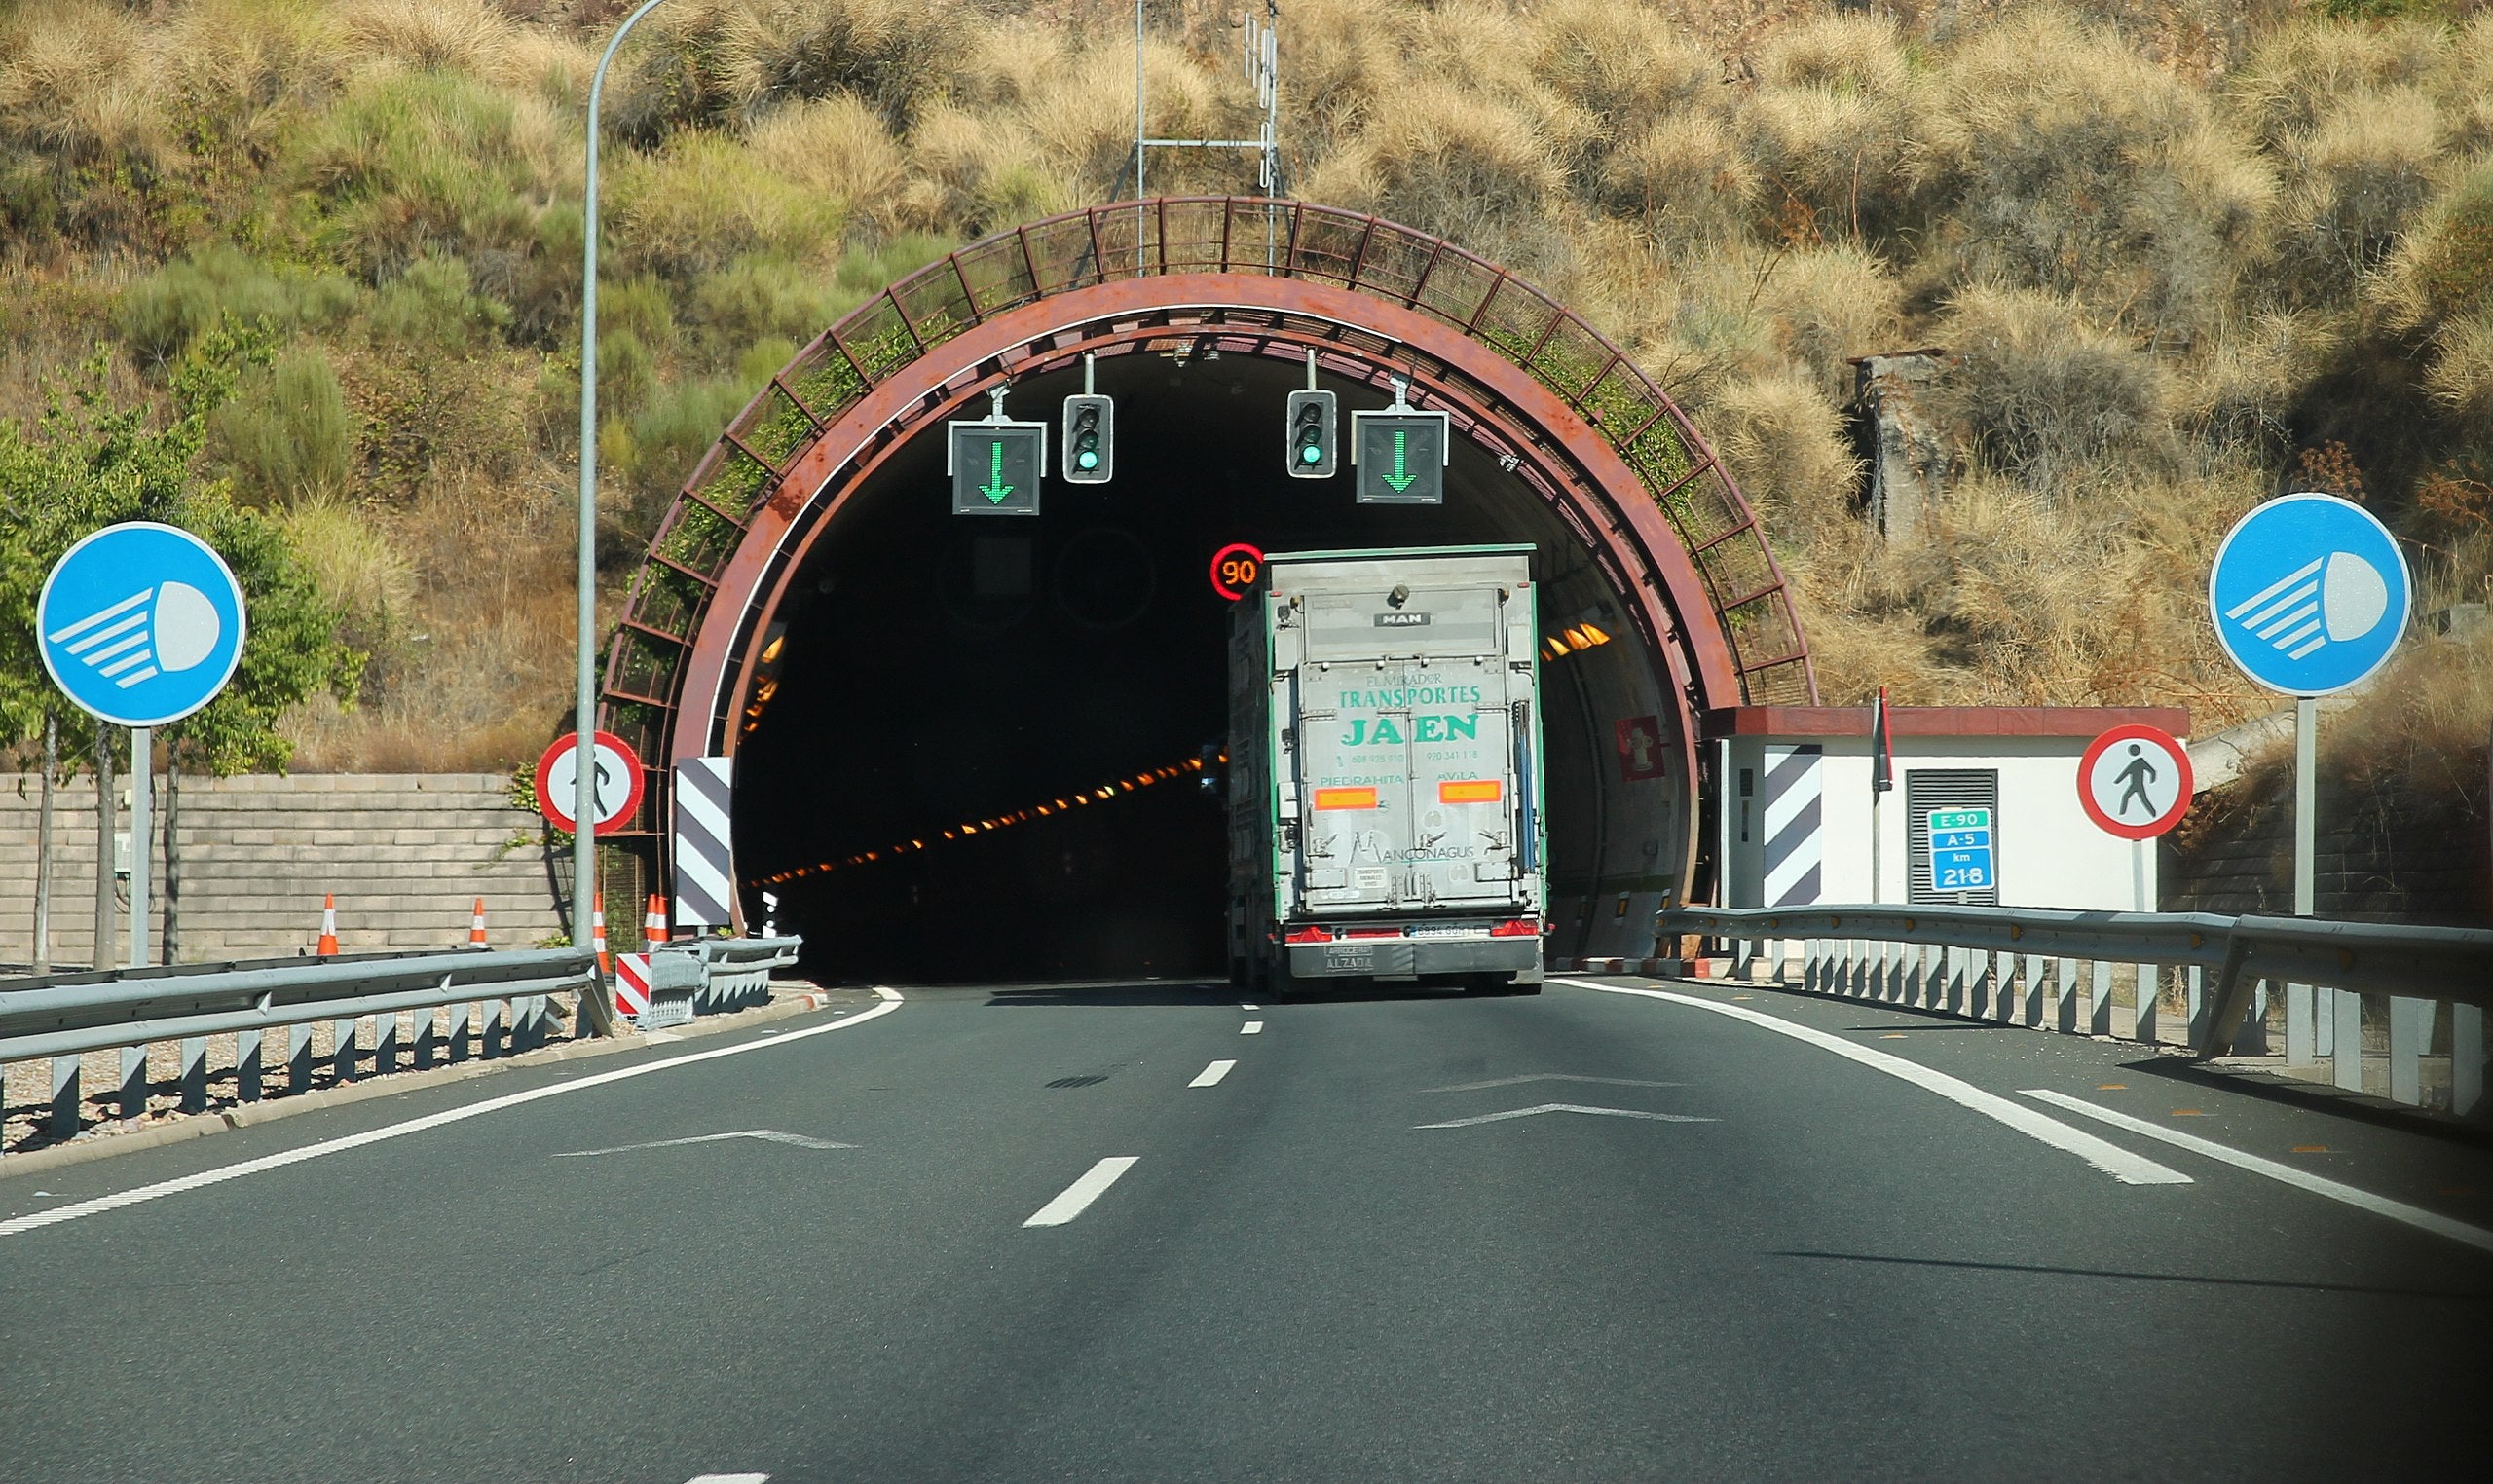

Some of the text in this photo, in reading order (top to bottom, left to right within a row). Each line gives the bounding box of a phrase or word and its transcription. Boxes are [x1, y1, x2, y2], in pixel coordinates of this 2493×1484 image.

[1223, 561, 1256, 584] 90
[1383, 614, 1422, 624] MAN
[1340, 686, 1480, 708] TRANSPORTES
[1340, 714, 1478, 746] JAEN
[1427, 752, 1441, 761] 920
[1321, 775, 1404, 786] PIEDRAHITA
[1941, 813, 1978, 827] E-90
[1947, 834, 1975, 846] A-5
[1953, 853, 1971, 863] km
[1943, 867, 1984, 886] 218
